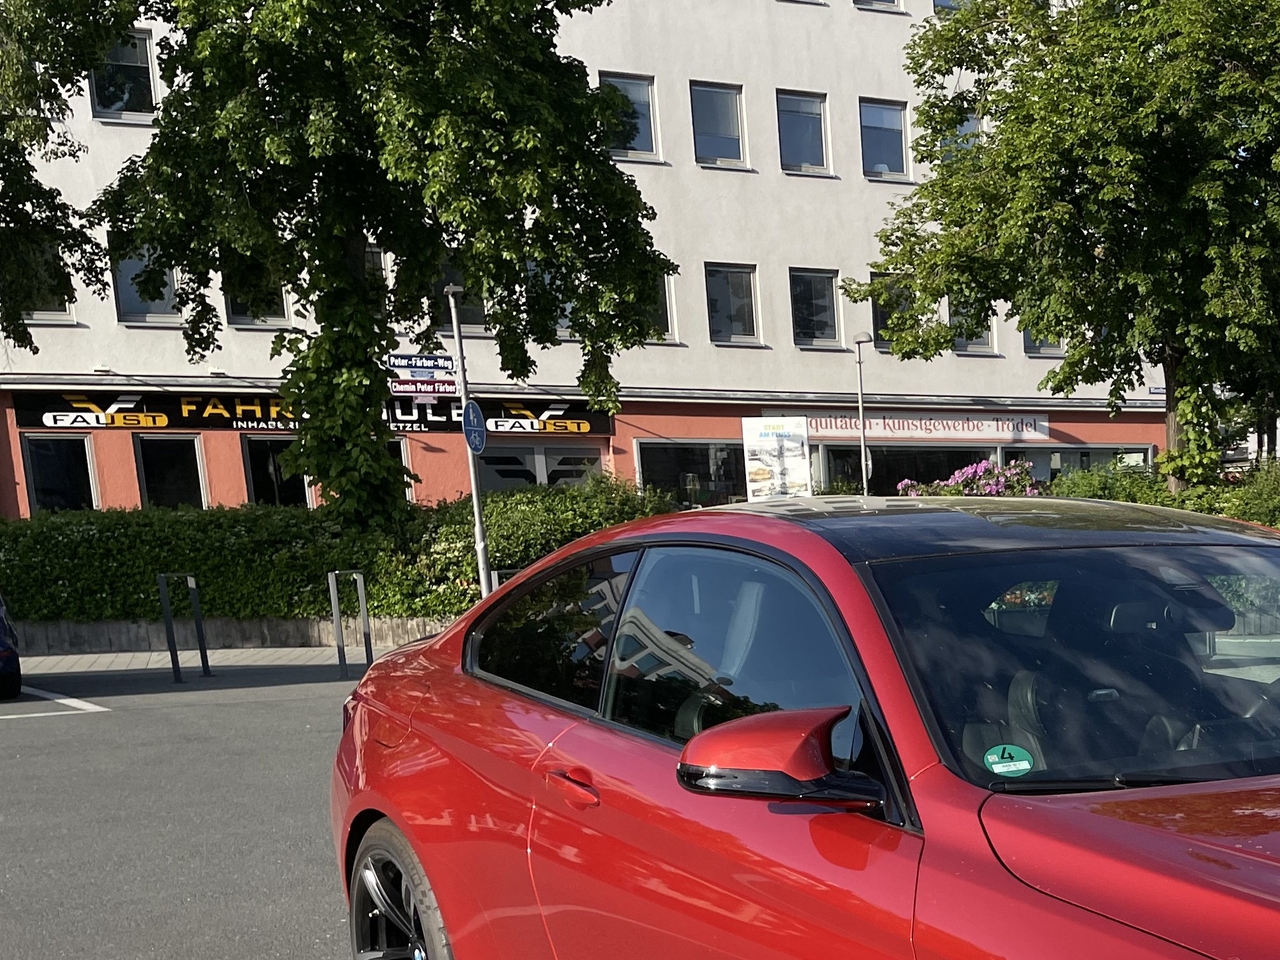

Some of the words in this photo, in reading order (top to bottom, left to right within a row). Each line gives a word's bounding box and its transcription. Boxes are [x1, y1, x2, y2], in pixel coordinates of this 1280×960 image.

[390, 356, 452, 369] Peter-Färber-Weg
[392, 382, 416, 392] Chemin
[417, 382, 433, 392] Peter
[434, 382, 456, 392] Färber
[180, 397, 463, 421] FAHRULE
[52, 414, 161, 426] FAUST
[494, 420, 588, 432] FAUST
[883, 416, 985, 434] Kunstgewerbe
[991, 416, 1037, 433] Trödel
[388, 423, 429, 431] ETZEL
[1000, 746, 1015, 761] 4
